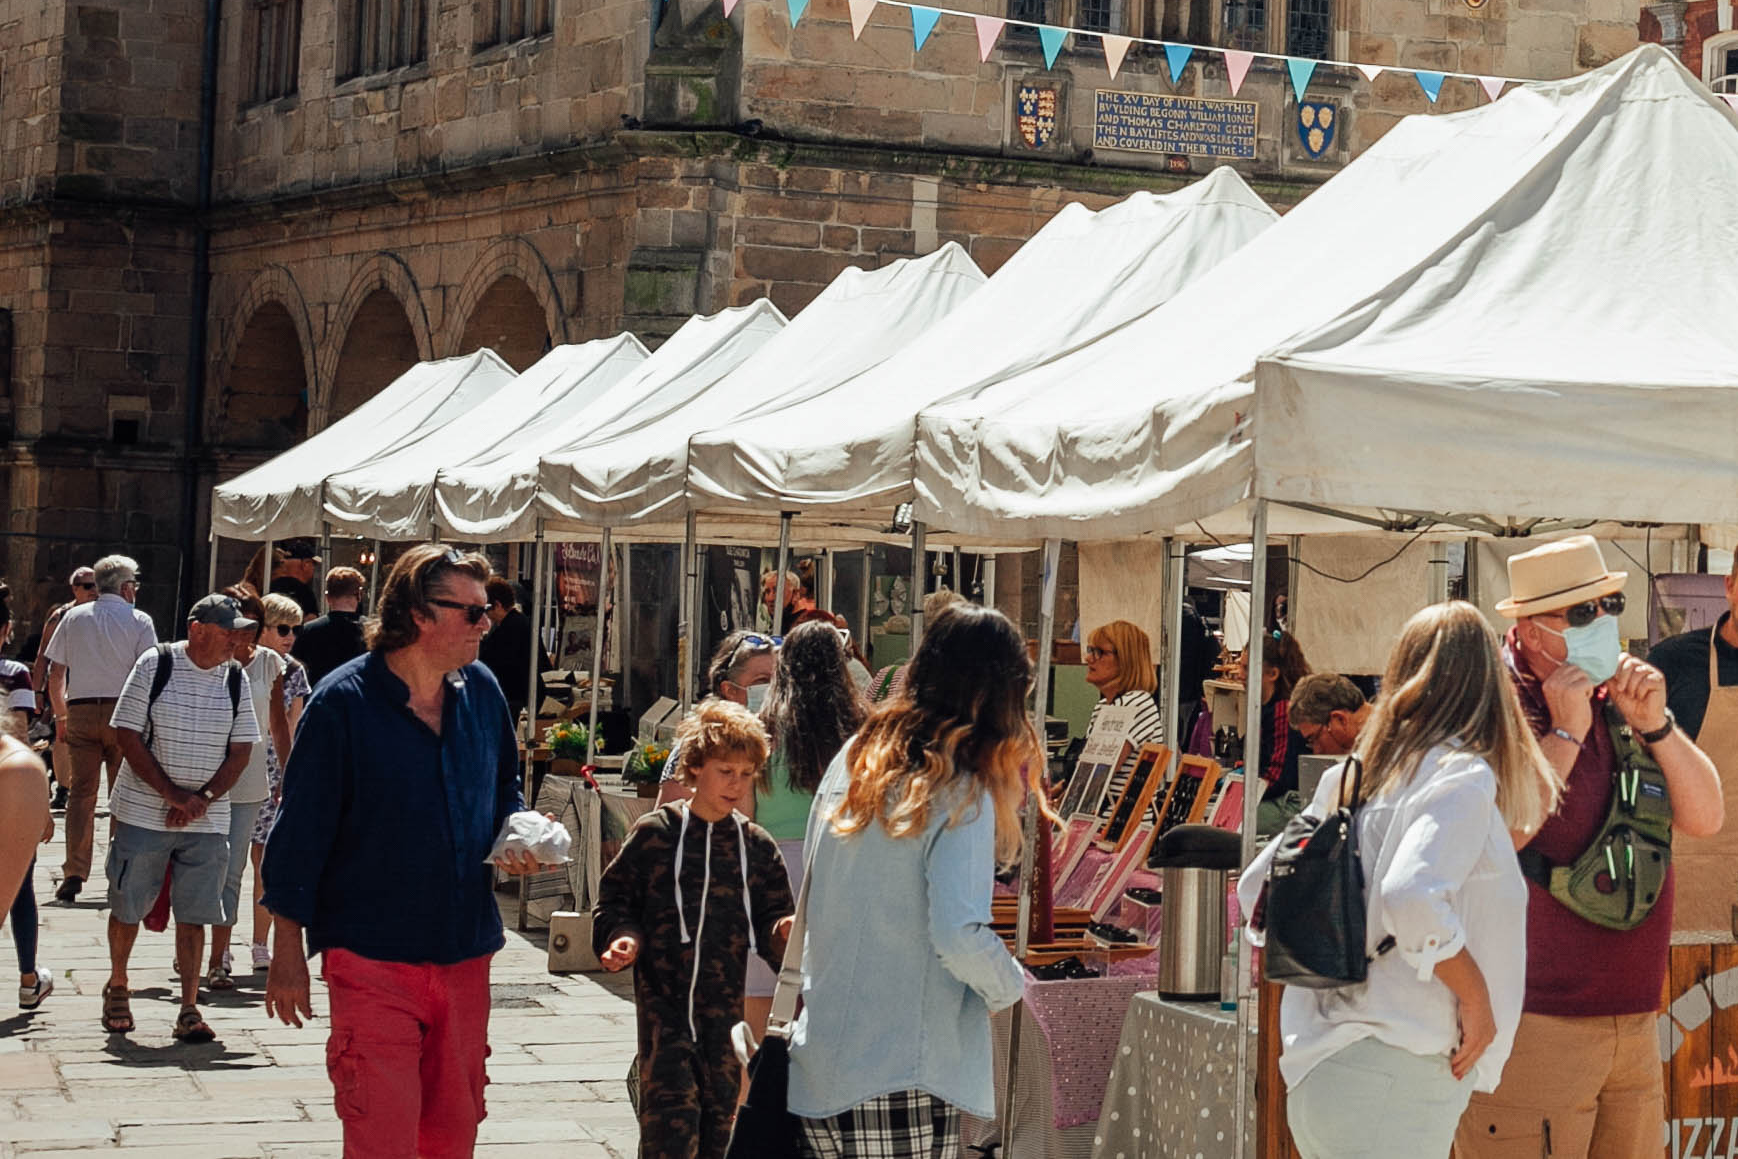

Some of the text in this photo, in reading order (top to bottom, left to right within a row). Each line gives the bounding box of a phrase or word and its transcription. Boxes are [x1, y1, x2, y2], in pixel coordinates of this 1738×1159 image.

[1098, 92, 1252, 113] THE XV DAY OF IVNE WAS THIS
[1098, 113, 1254, 134] AND THOMAS CHARLTON GENT
[1099, 103, 1147, 116] BVYLDING
[1189, 110, 1225, 122] WILLIAM
[1227, 113, 1254, 124] IONES
[1096, 136, 1237, 155] AND COVERED IN THEIR TIME
[1180, 132, 1196, 141] AND
[1196, 133, 1216, 143] WAS
[1217, 135, 1254, 146] ERECTED
